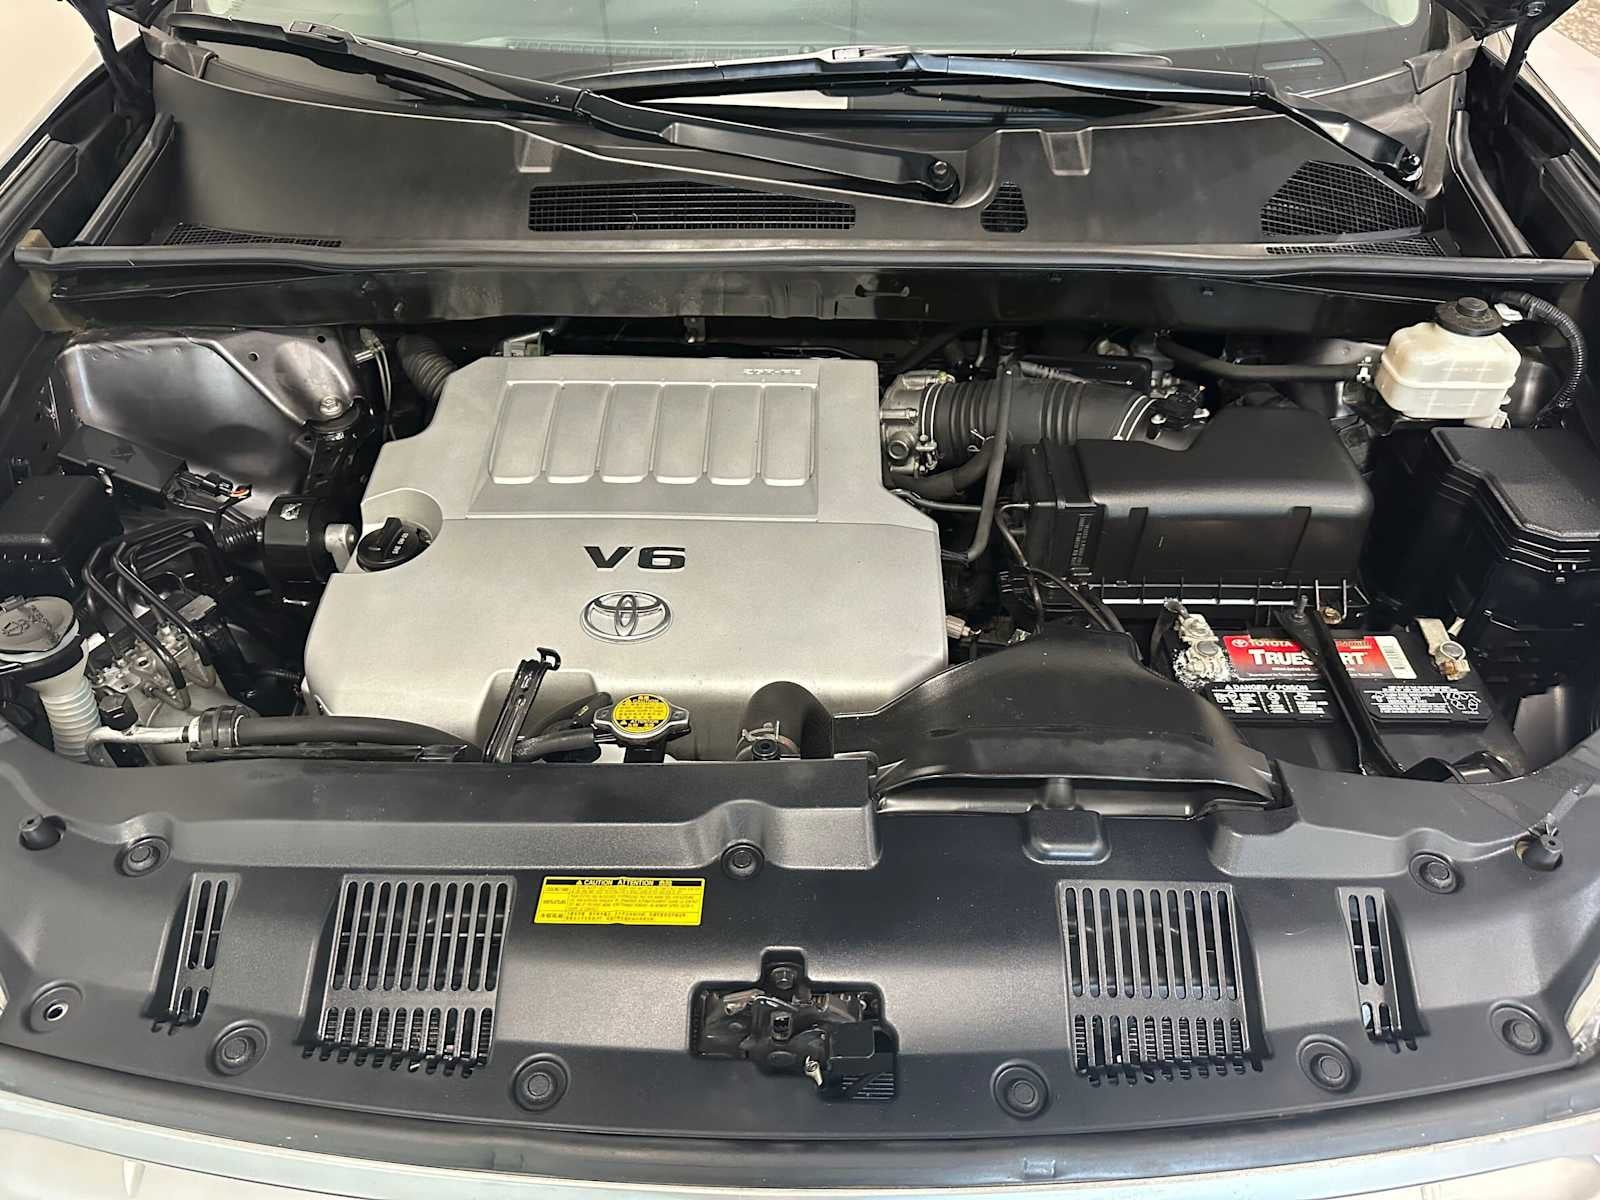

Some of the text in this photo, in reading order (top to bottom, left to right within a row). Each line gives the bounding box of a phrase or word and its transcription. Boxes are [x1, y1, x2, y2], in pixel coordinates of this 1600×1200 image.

[583, 546, 686, 570] V6
[1276, 684, 1309, 692] POISON
[617, 879, 654, 887] ATTENTION
